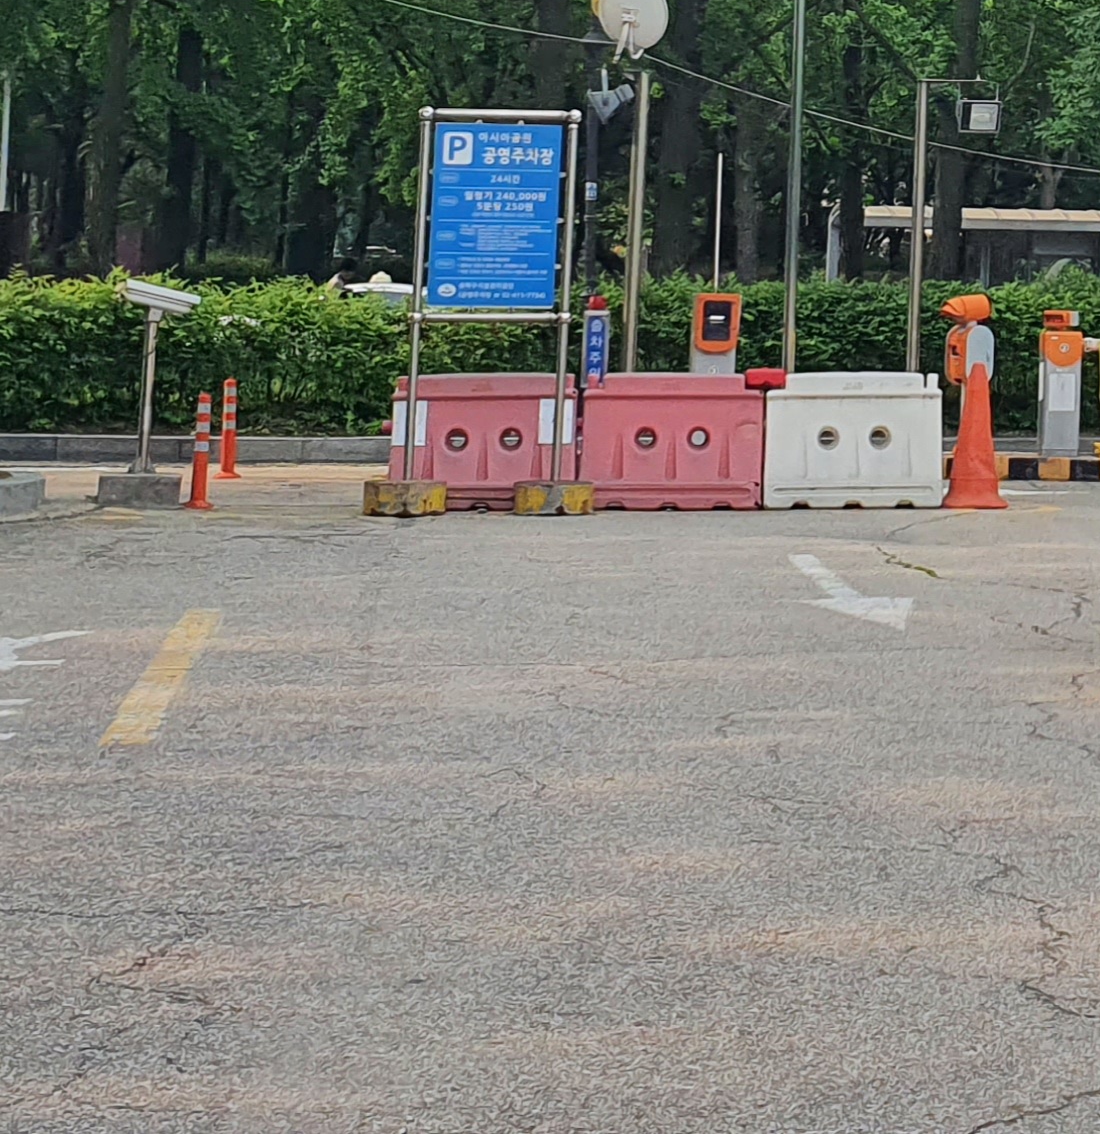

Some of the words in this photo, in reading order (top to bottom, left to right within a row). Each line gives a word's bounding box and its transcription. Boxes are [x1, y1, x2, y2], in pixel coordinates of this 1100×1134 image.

[478, 131, 532, 144] 아시아공원
[448, 135, 467, 161] P
[482, 146, 554, 166] 공영주차장
[490, 174, 521, 184] 24시간
[495, 191, 547, 202] 240,000원
[504, 202, 534, 212] 250원
